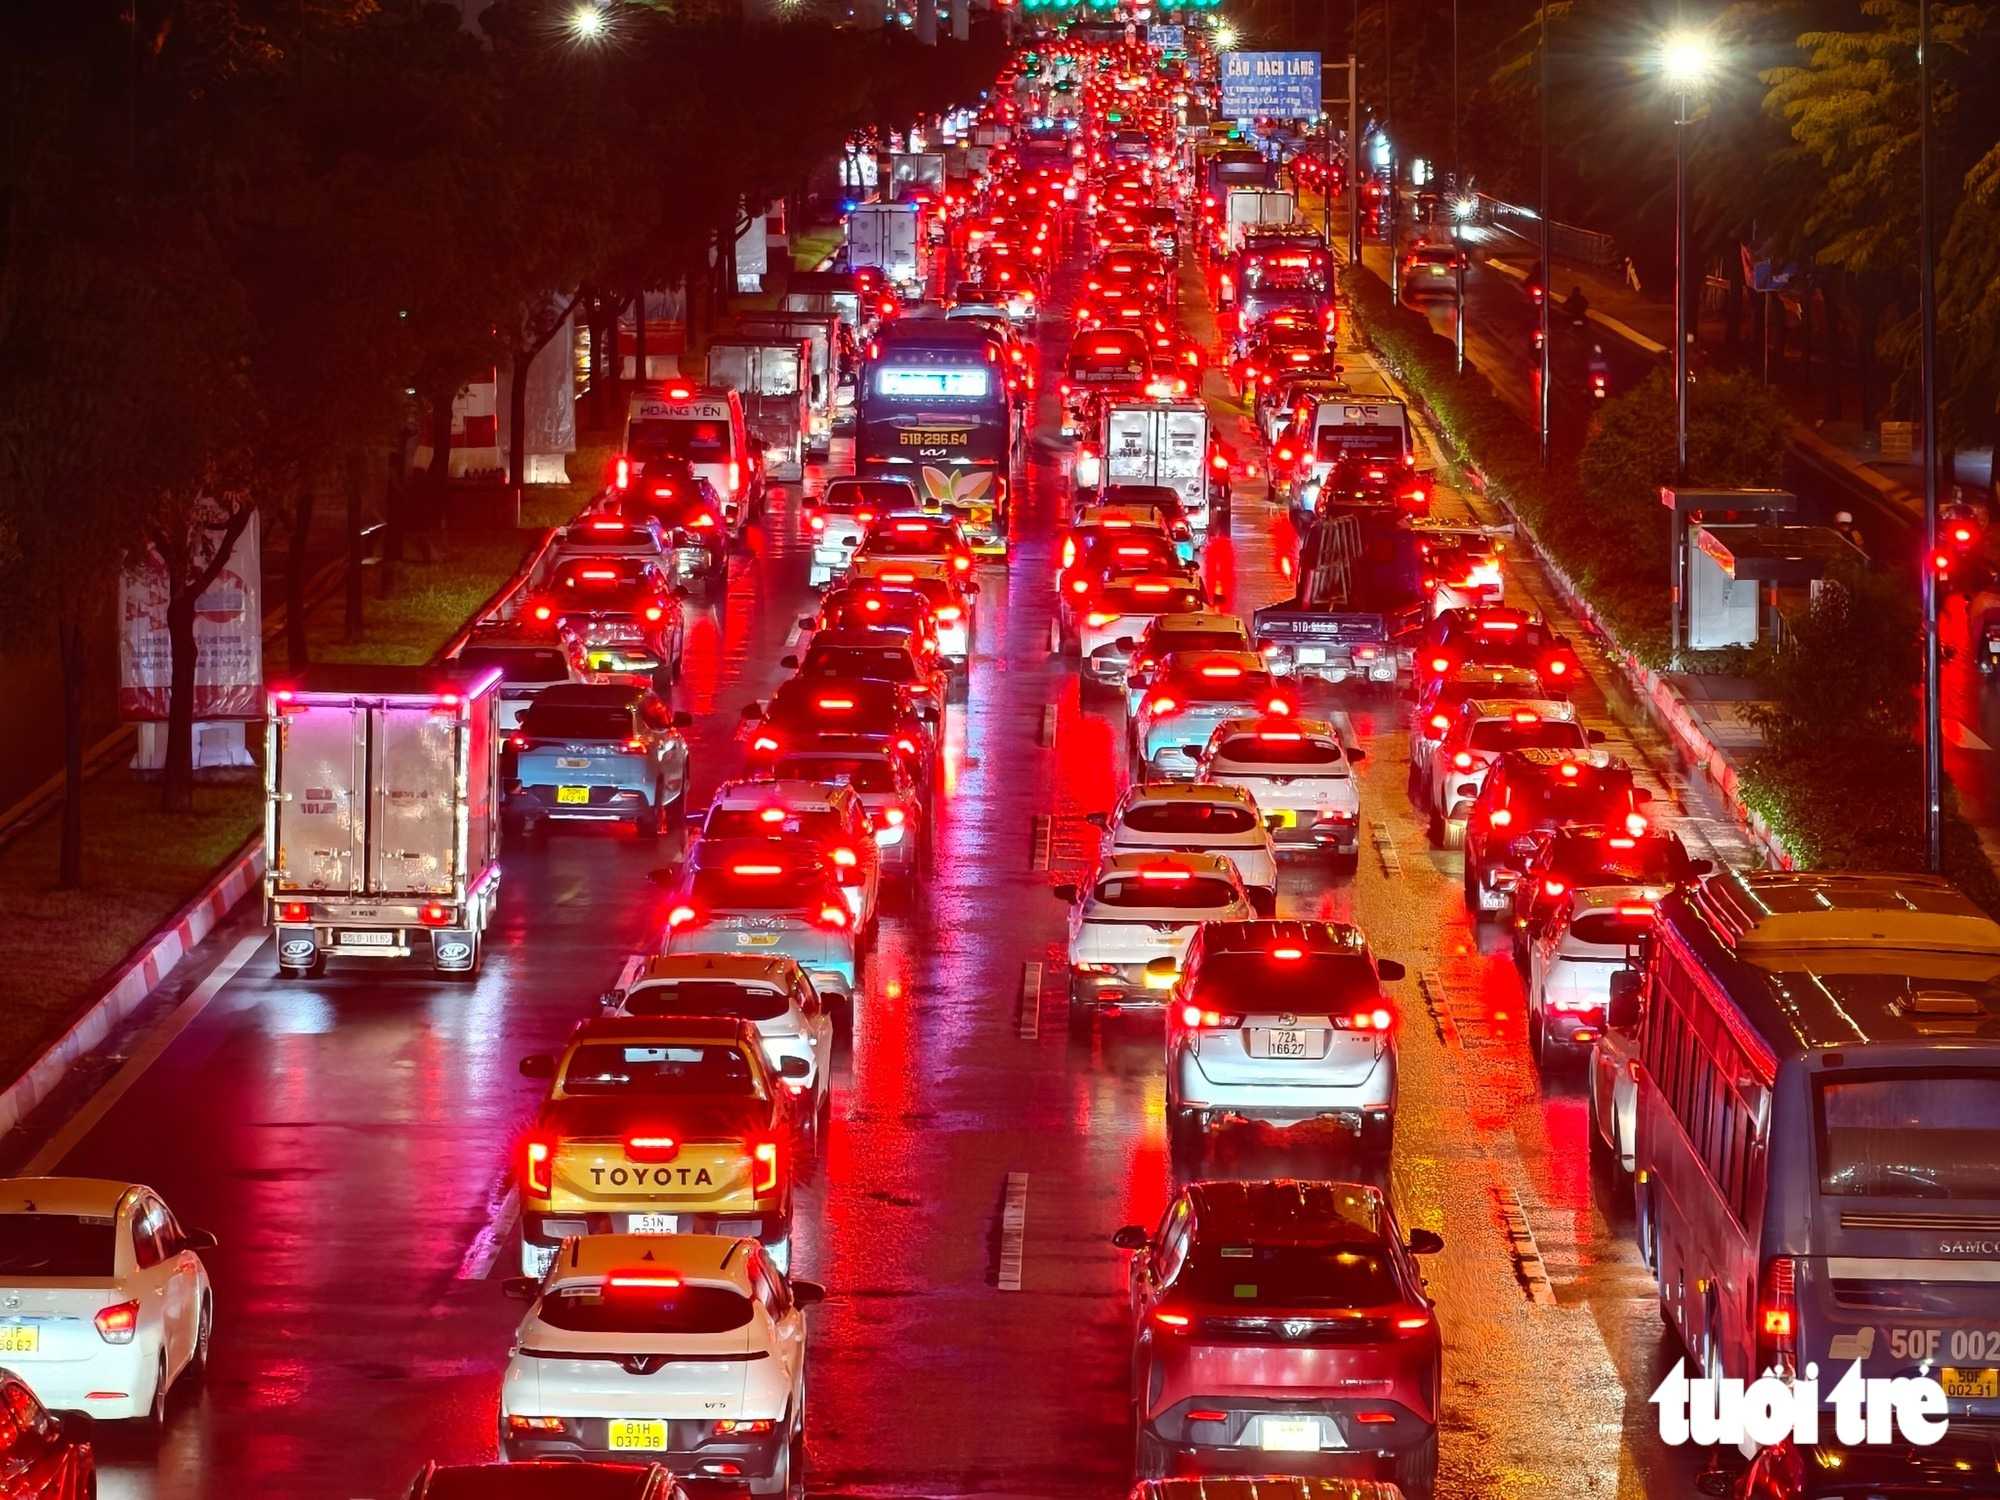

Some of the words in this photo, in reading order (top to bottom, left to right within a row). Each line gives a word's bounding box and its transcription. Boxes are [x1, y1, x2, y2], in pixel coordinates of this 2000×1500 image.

[1278, 1032, 1297, 1043] 72A
[590, 1168, 713, 1186] TOYOTA
[643, 1216, 664, 1227] 51N
[1890, 1329, 1942, 1360] 50F
[1950, 1330, 2000, 1361] 002
[1957, 1370, 1981, 1384] 50F
[626, 1423, 651, 1434] 81H
